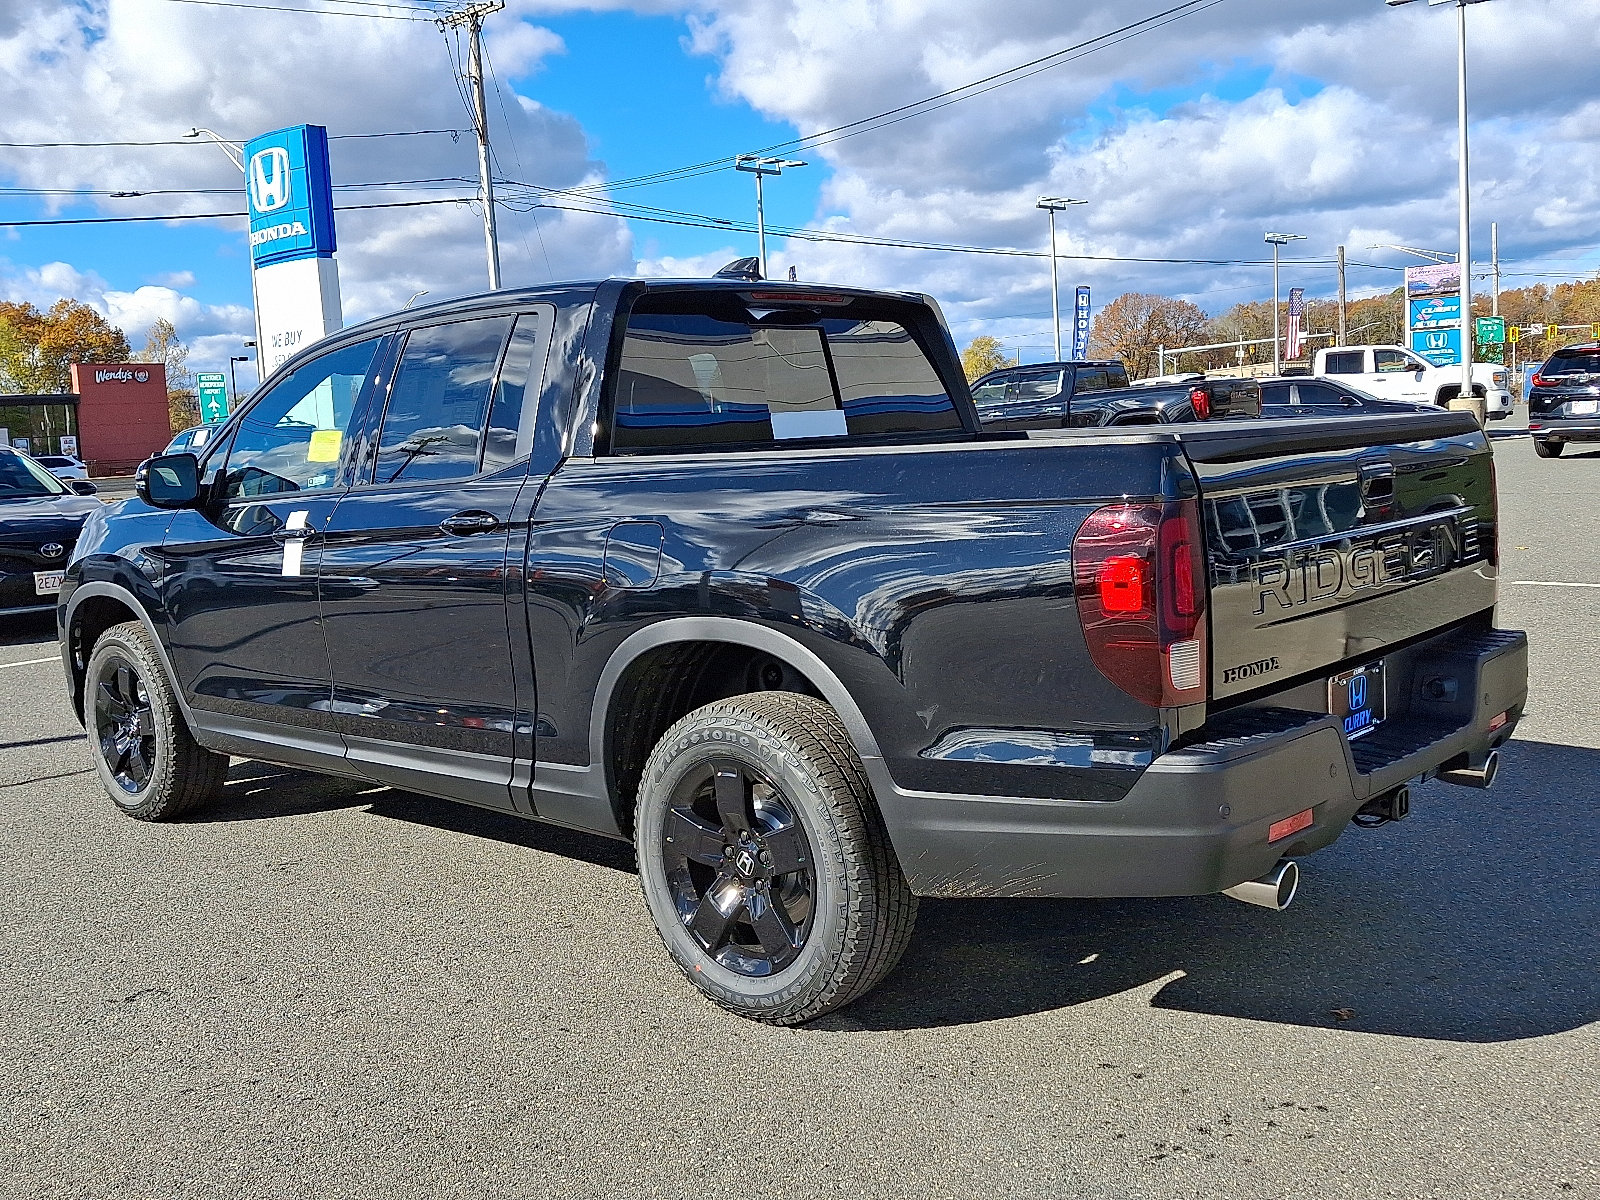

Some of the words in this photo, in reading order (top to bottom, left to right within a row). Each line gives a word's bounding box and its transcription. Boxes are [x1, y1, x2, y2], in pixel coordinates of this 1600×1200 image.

[250, 221, 308, 246] HONDA
[284, 329, 303, 346] BUY
[1075, 309, 1089, 360] HONDA
[95, 367, 133, 384] Wendy's
[1250, 516, 1480, 615] RIDGELINE
[1222, 656, 1282, 684] HONDA
[1344, 708, 1372, 733] CURRY
[657, 728, 750, 775] Firestone
